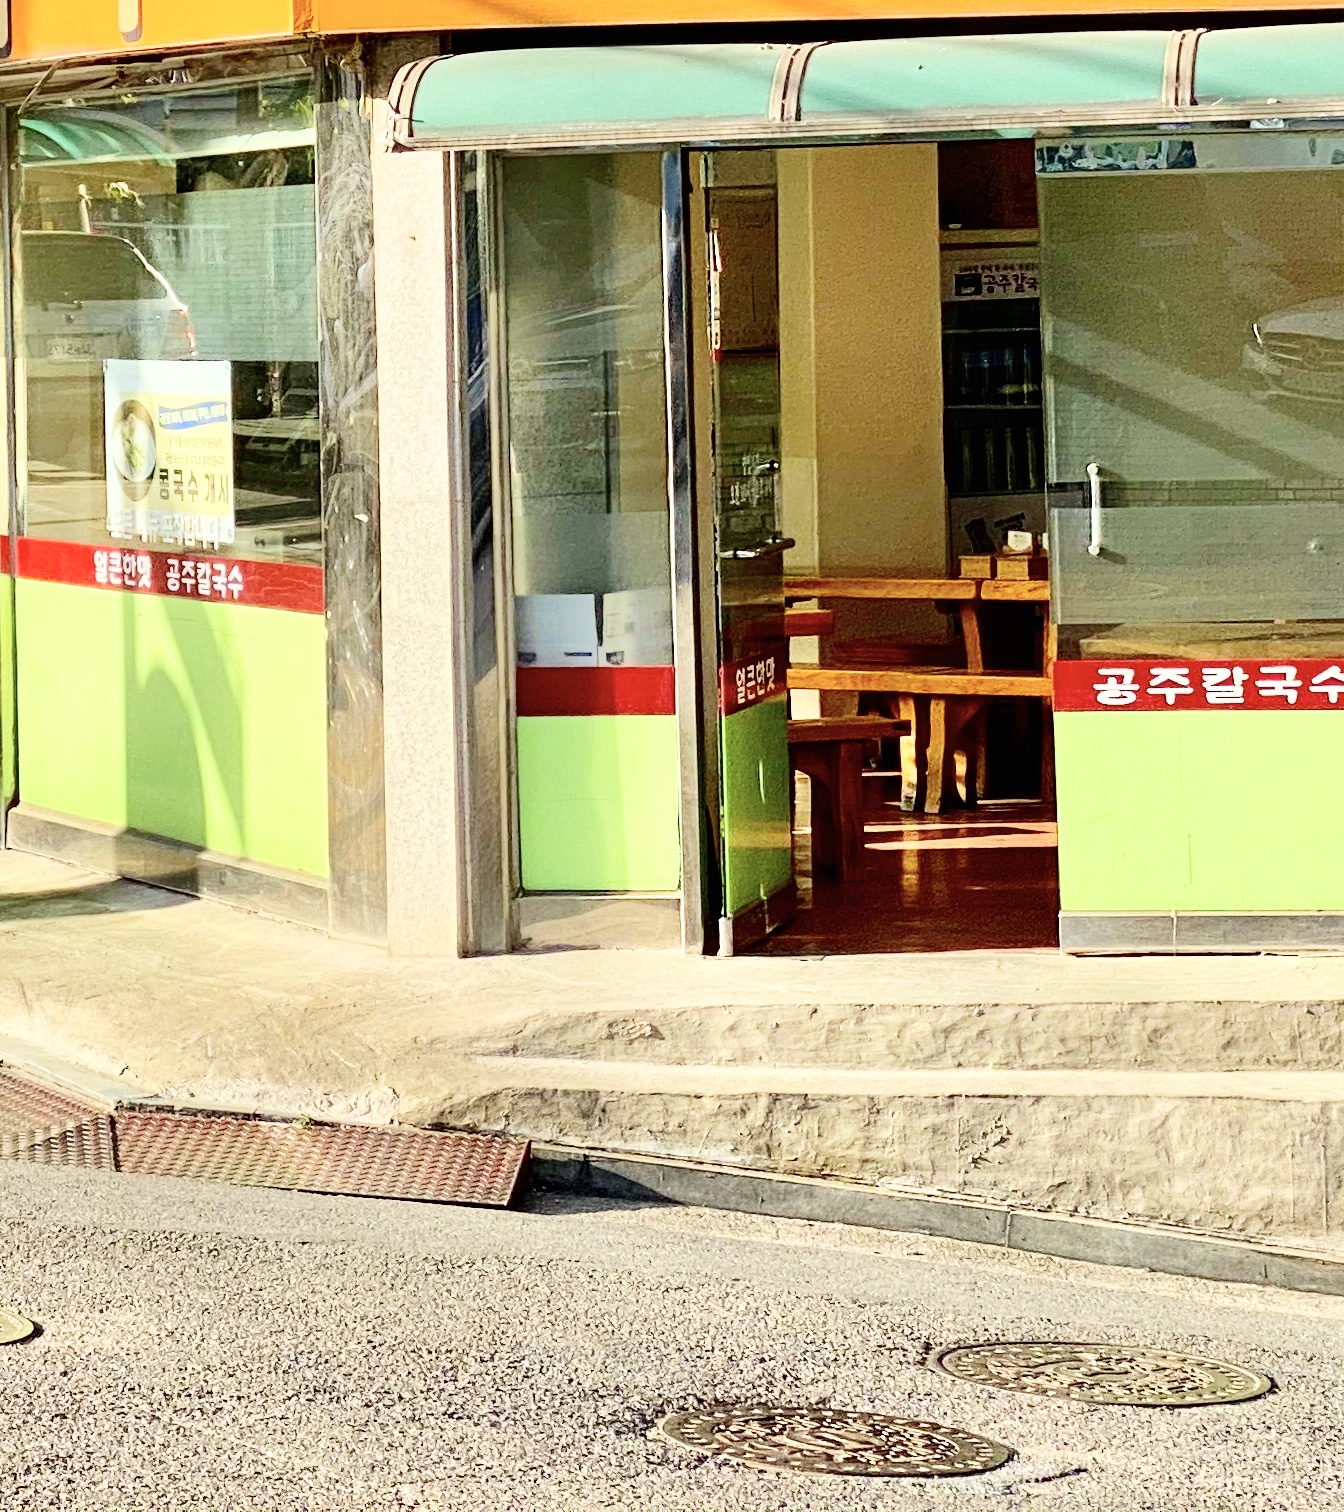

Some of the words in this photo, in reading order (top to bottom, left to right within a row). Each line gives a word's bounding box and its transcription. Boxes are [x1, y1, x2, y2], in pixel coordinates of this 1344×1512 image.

[159, 467, 200, 503] 콩국수
[93, 549, 153, 589] 얼큰한맛
[165, 558, 244, 600] 공주칼국수
